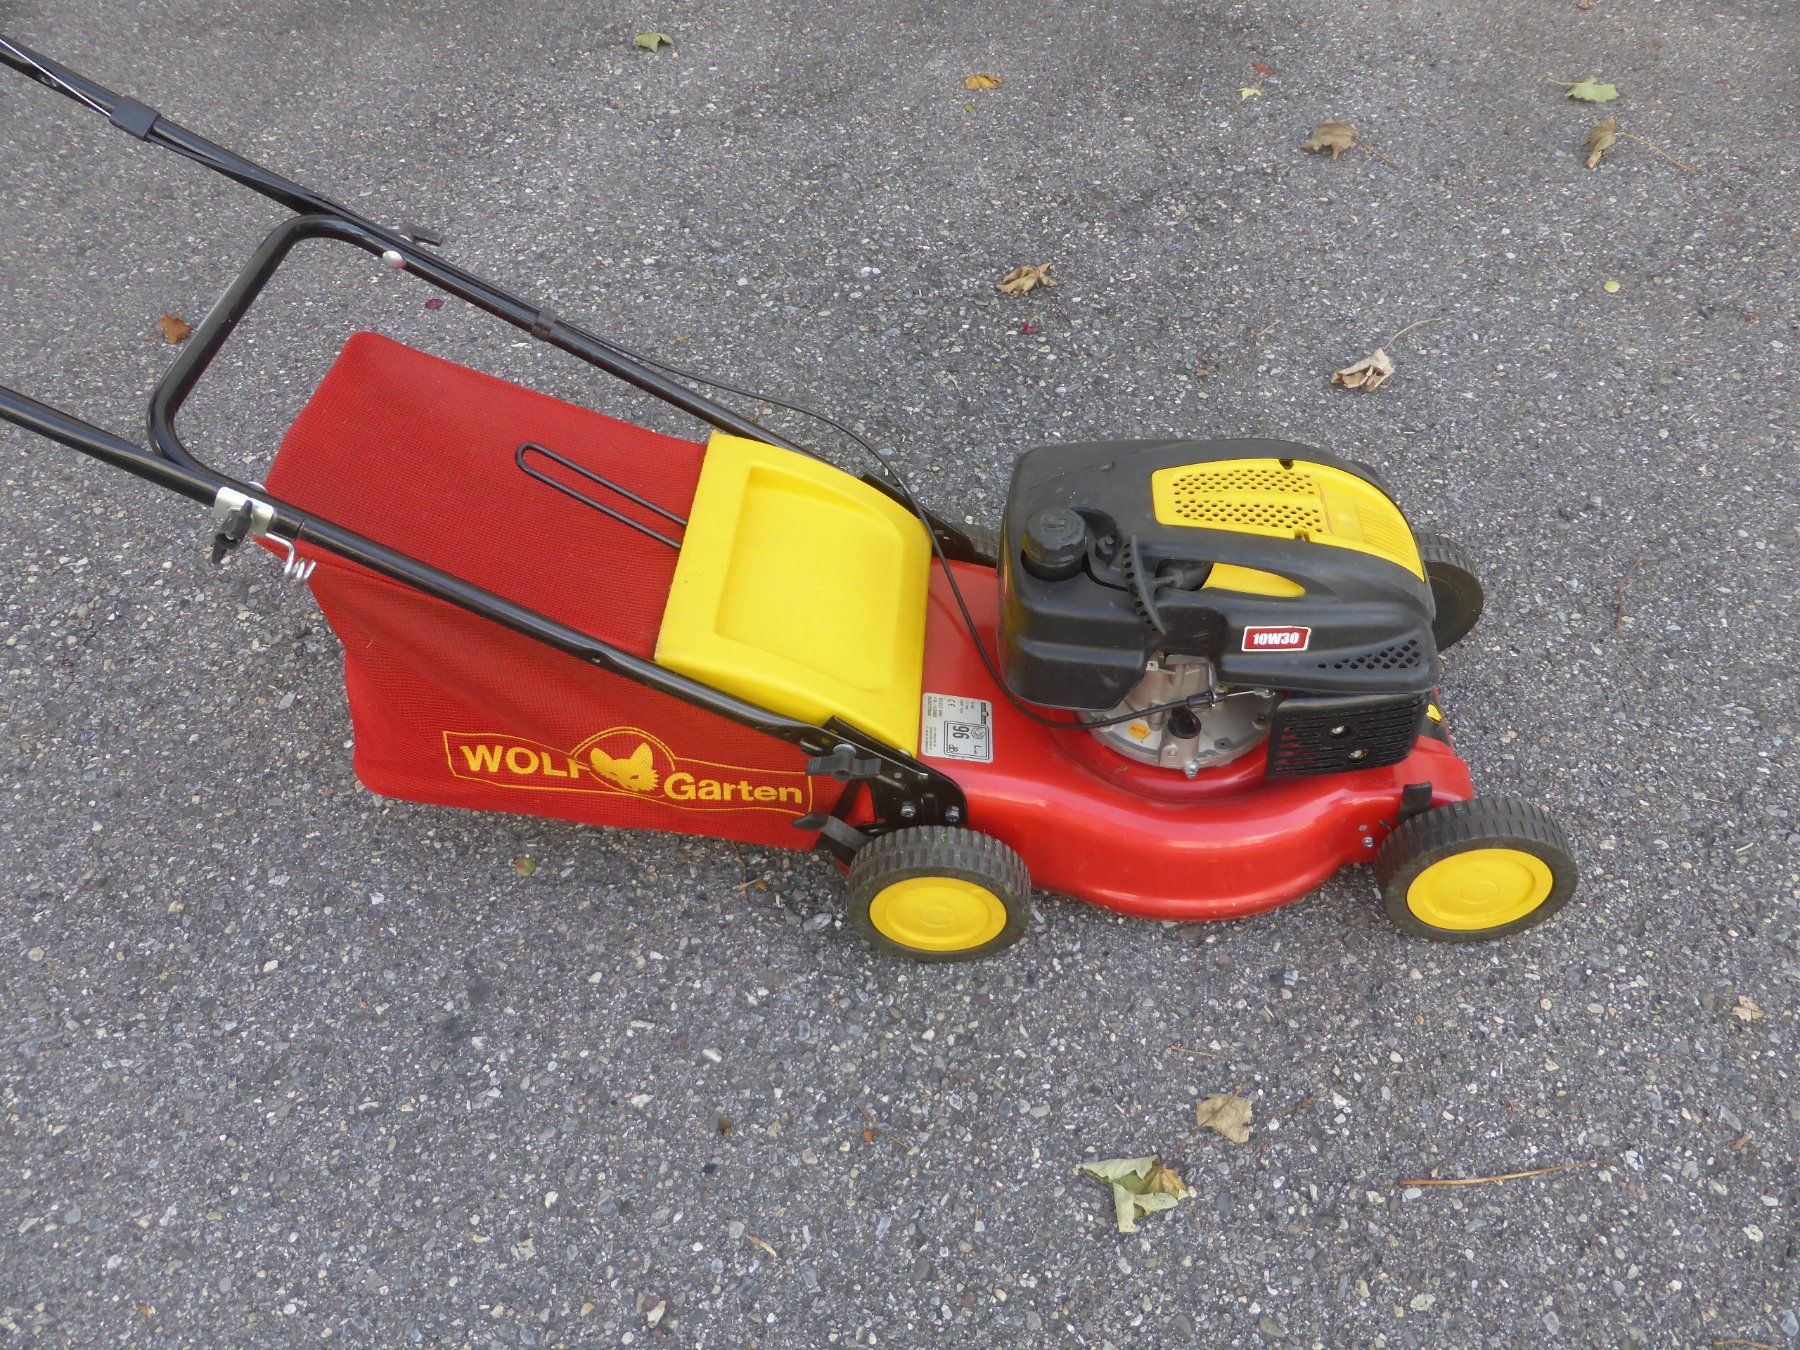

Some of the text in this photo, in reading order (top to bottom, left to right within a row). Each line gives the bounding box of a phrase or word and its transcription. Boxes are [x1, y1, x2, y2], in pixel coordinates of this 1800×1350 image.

[1253, 632, 1300, 645] 10W30
[952, 724, 970, 740] 96
[663, 772, 803, 803] Garten
